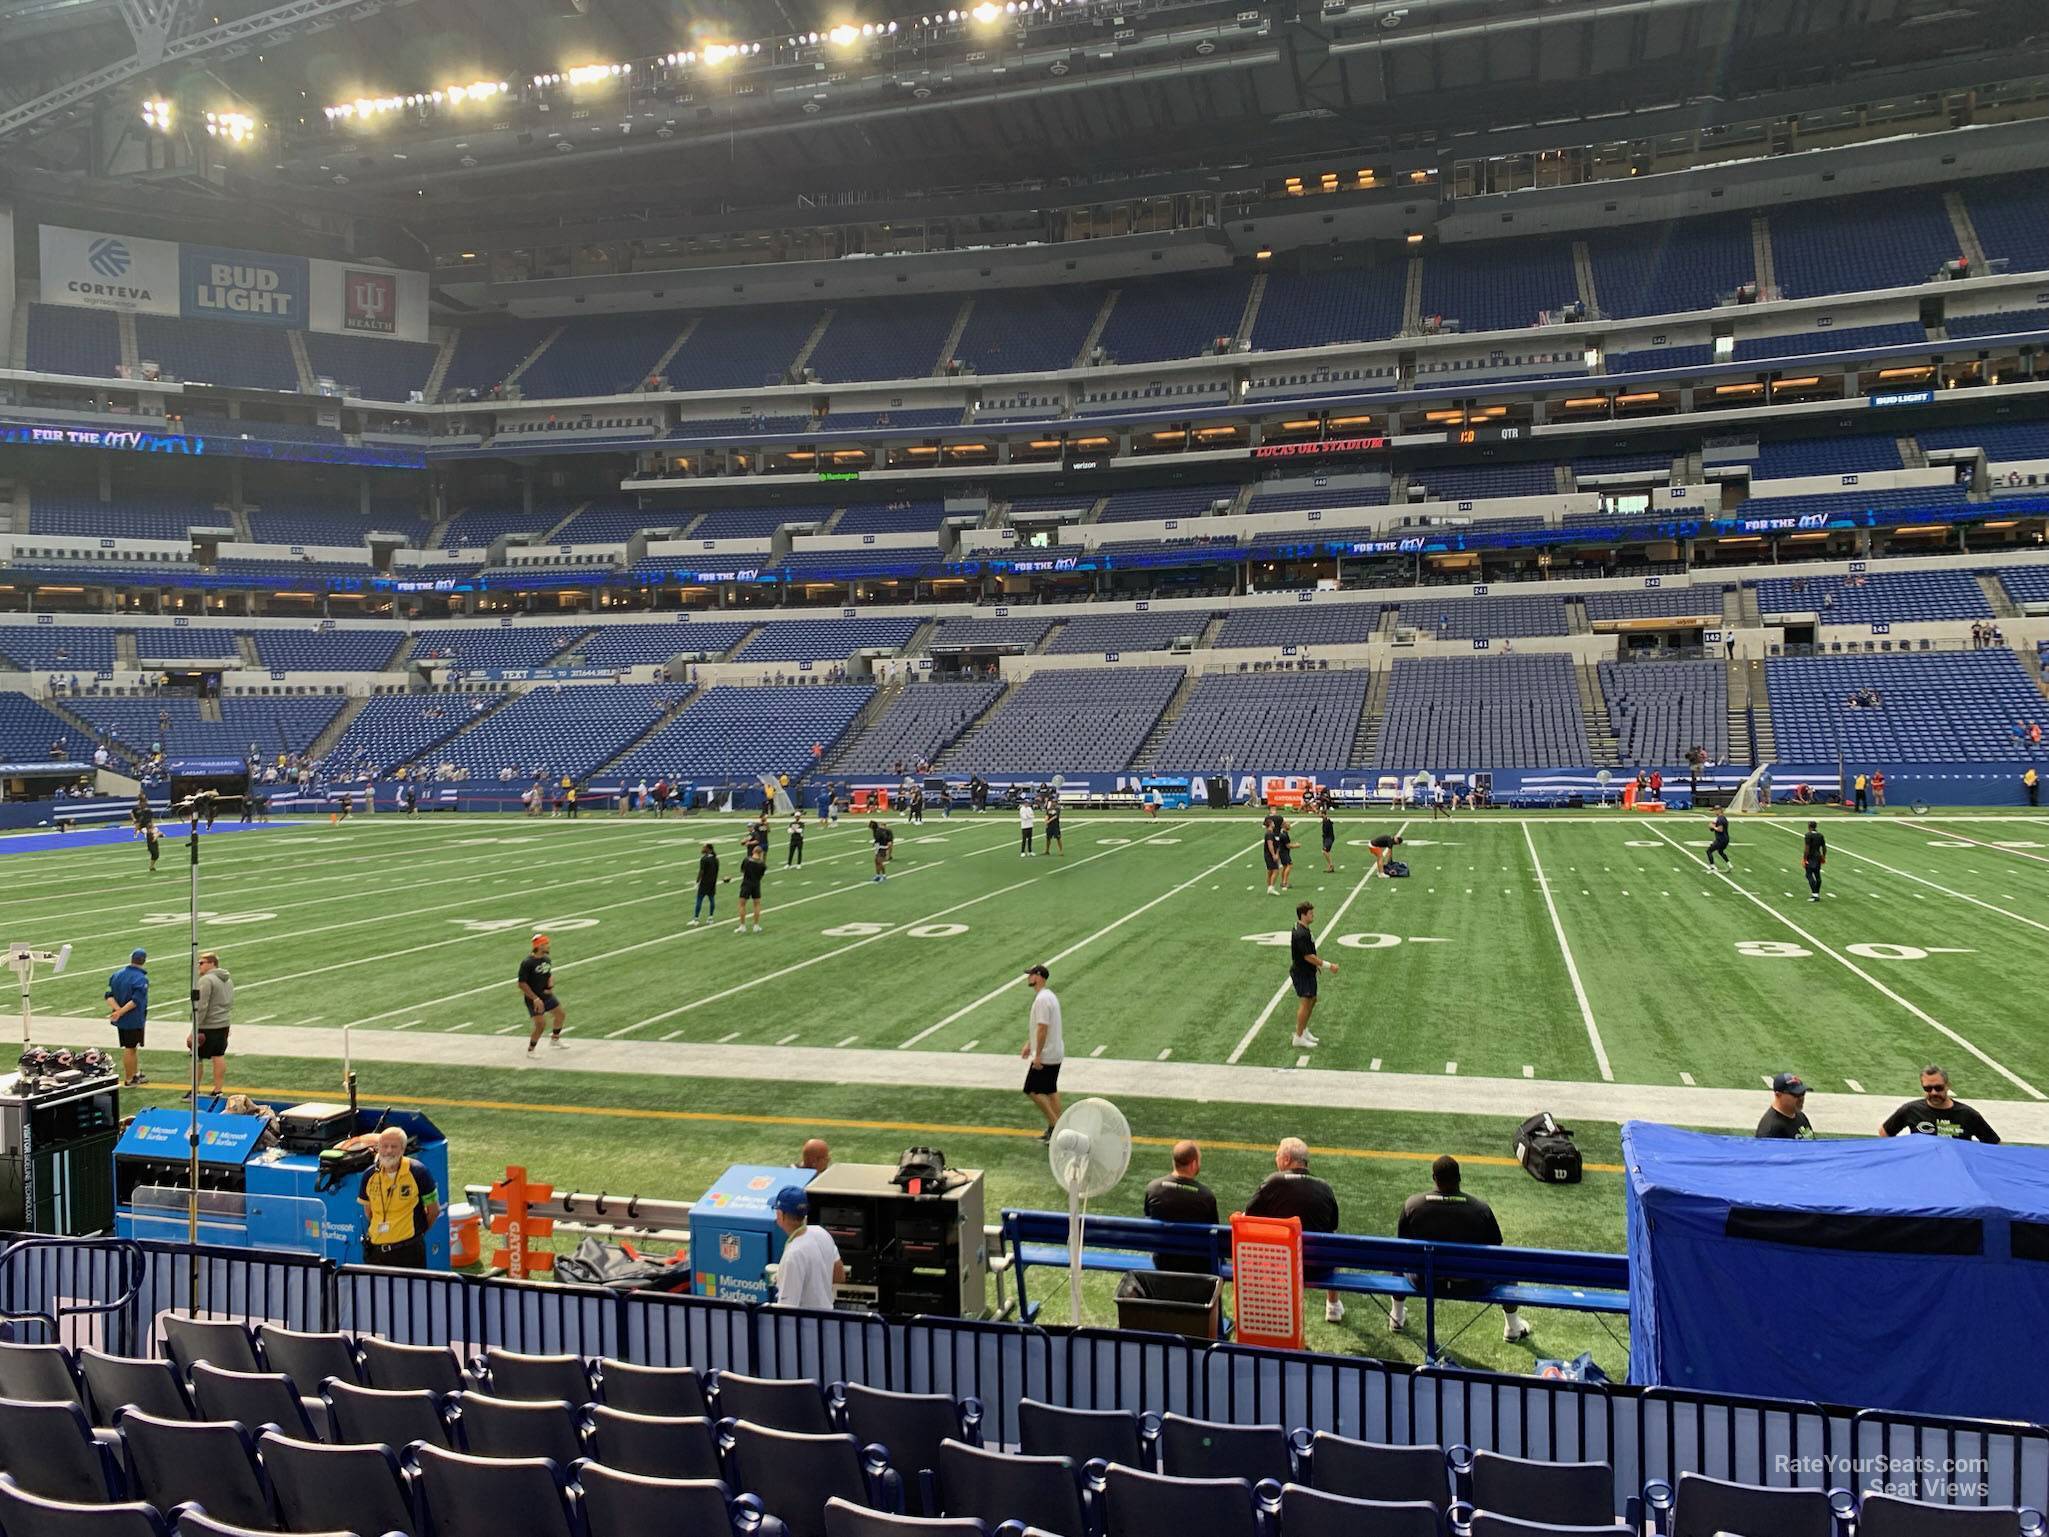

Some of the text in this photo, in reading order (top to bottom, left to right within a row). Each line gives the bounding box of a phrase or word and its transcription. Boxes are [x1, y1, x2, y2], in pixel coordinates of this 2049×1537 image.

[211, 264, 279, 291] BUD
[68, 281, 152, 301] CORTEVA
[198, 285, 291, 314] LIGHT
[348, 319, 393, 330] HEALTH
[1876, 393, 1928, 404] BUD LIGHT
[32, 429, 63, 440] FOR
[67, 431, 99, 443] THE
[1501, 428, 1519, 439] QTR
[1256, 439, 1383, 457] LUCAS OIL STADIUM
[1073, 461, 1096, 469] verizon
[1745, 520, 1768, 530] FOR
[1770, 519, 1795, 528] THE
[1353, 543, 1373, 552] FOR
[1375, 542, 1397, 550] THE
[1015, 562, 1033, 570] FOR
[1850, 563, 1865, 572] 243
[698, 573, 715, 581] FOR
[416, 582, 434, 590] THE
[1645, 578, 1660, 587] 242
[1474, 586, 1488, 595] 241
[1872, 624, 1888, 633] 143
[1705, 633, 1720, 641] 142
[1474, 640, 1488, 649] 141
[1283, 646, 1296, 655] 140
[501, 670, 528, 679] TEXT
[219, 1132, 247, 1140] Microsoft
[23, 1123, 33, 1224] VISITOR SIDELINE TECHNOLOGY
[720, 1275, 767, 1291] Microsoft
[720, 1287, 757, 1303] Surface
